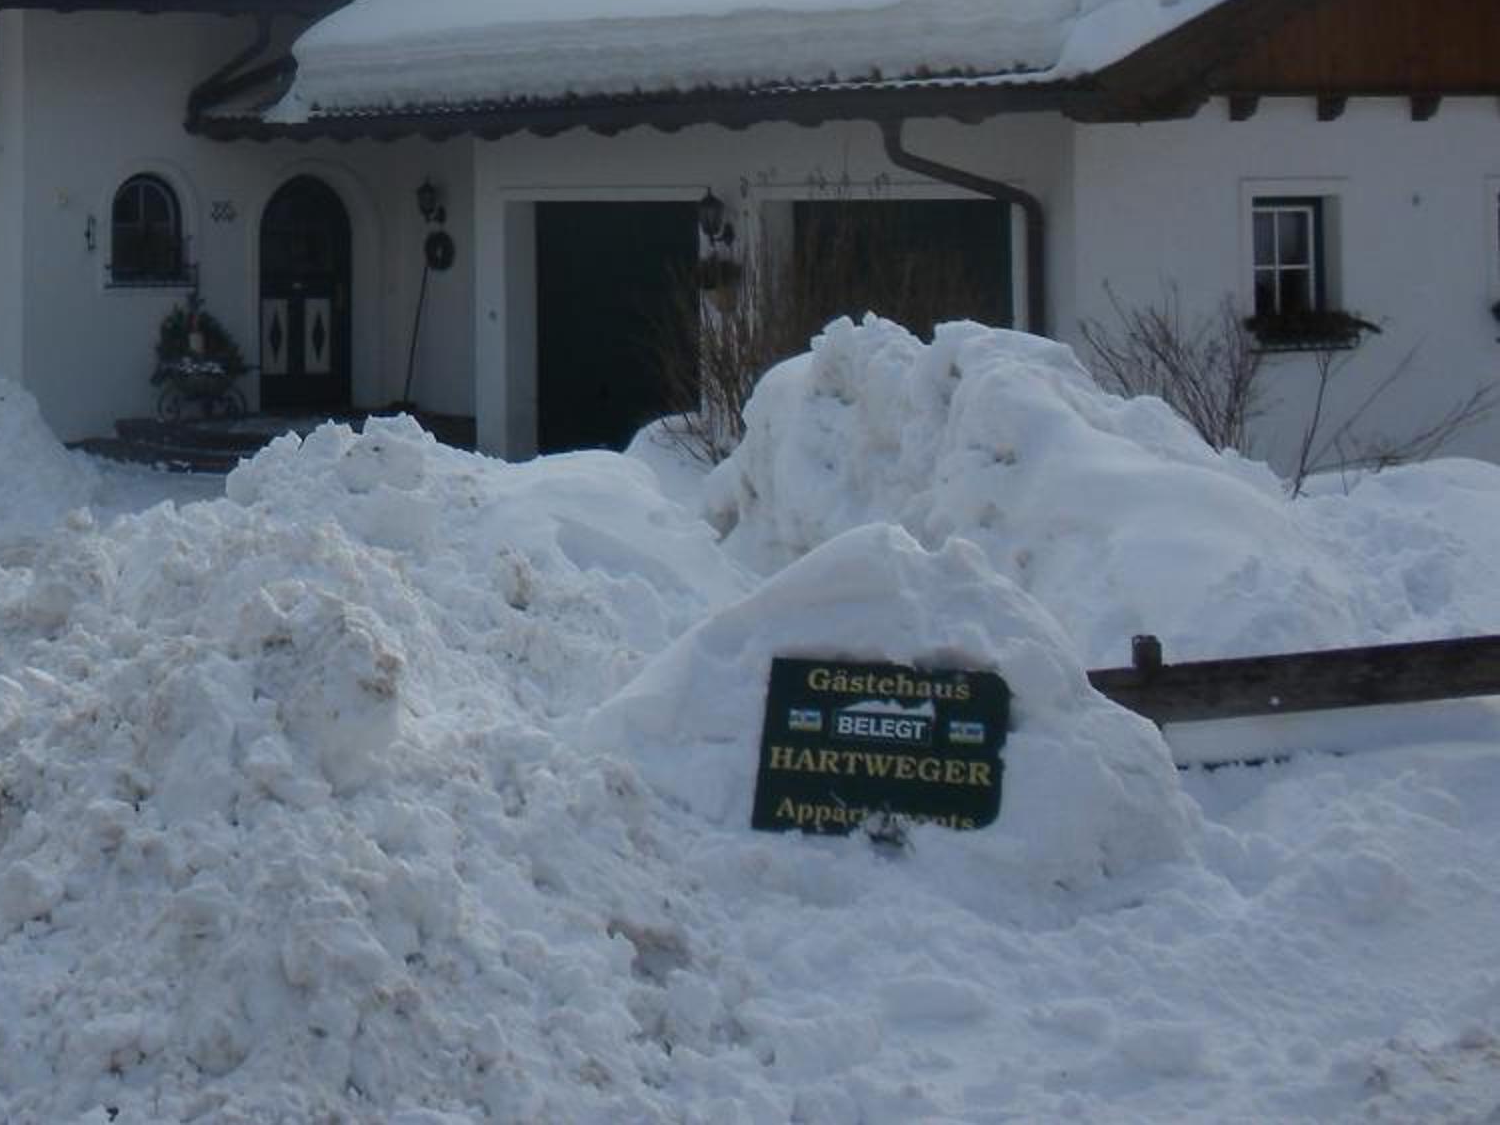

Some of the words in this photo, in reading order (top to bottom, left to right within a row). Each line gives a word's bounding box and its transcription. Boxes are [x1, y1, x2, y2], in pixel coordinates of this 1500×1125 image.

[807, 668, 971, 700] Gästehaus
[837, 716, 927, 740] BELEGT
[769, 746, 992, 787] HARTWEGER
[775, 796, 976, 830] Appartmnts
